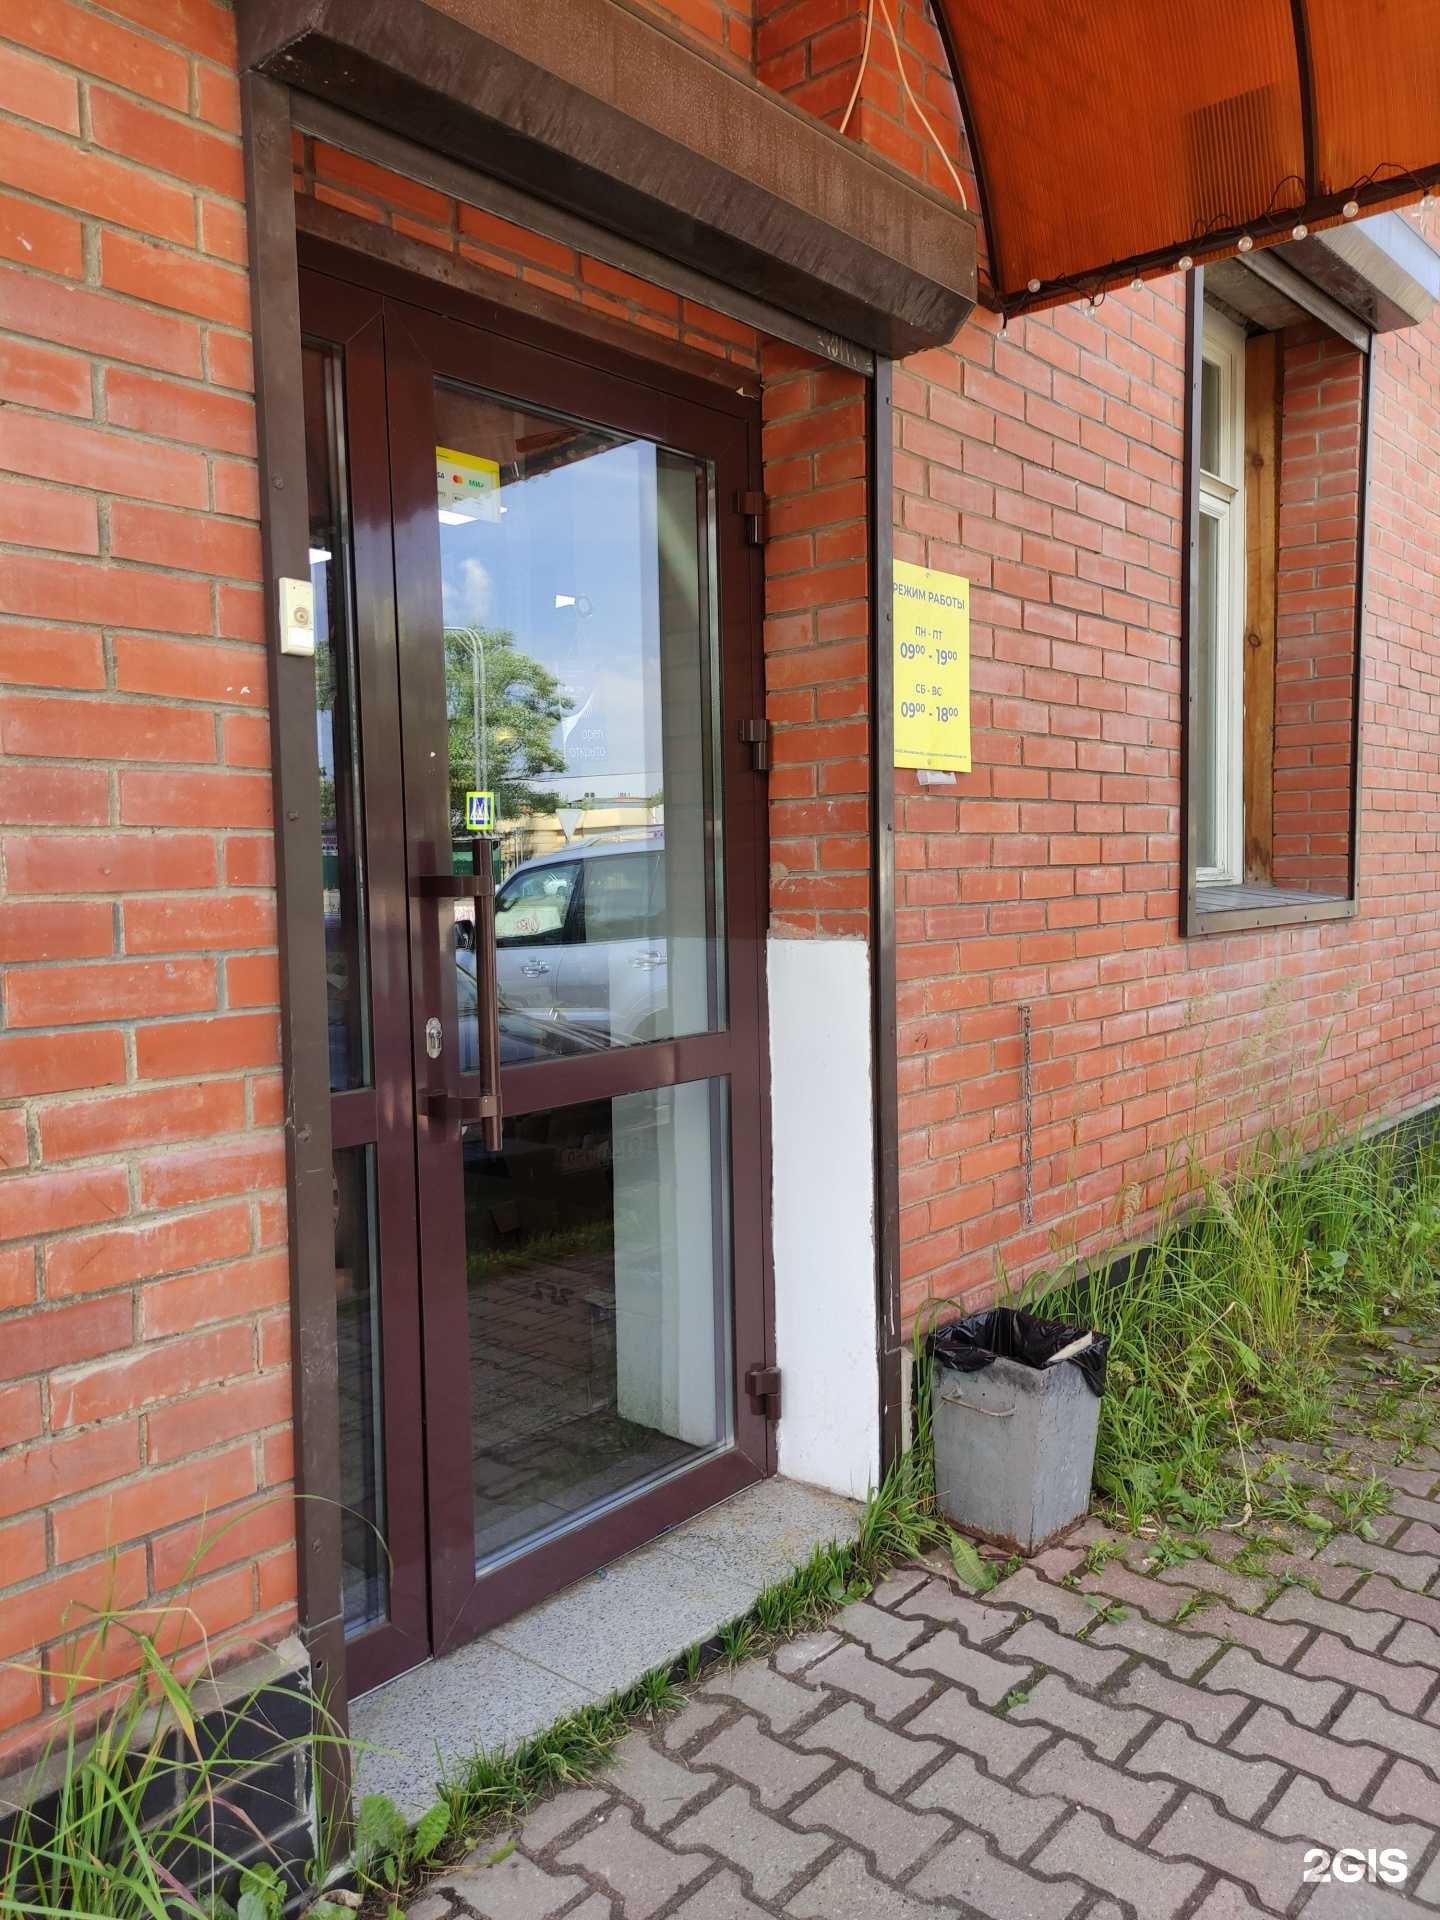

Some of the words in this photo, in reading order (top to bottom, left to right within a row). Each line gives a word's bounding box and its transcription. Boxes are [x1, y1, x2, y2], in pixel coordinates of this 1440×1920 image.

[893, 582, 926, 601] РЕЖИМ
[928, 591, 965, 609] РАБОТЫ
[915, 626, 926, 637] ПН
[932, 630, 943, 640] ПТ
[915, 683, 926, 694] СБ
[931, 686, 943, 696] ВС
